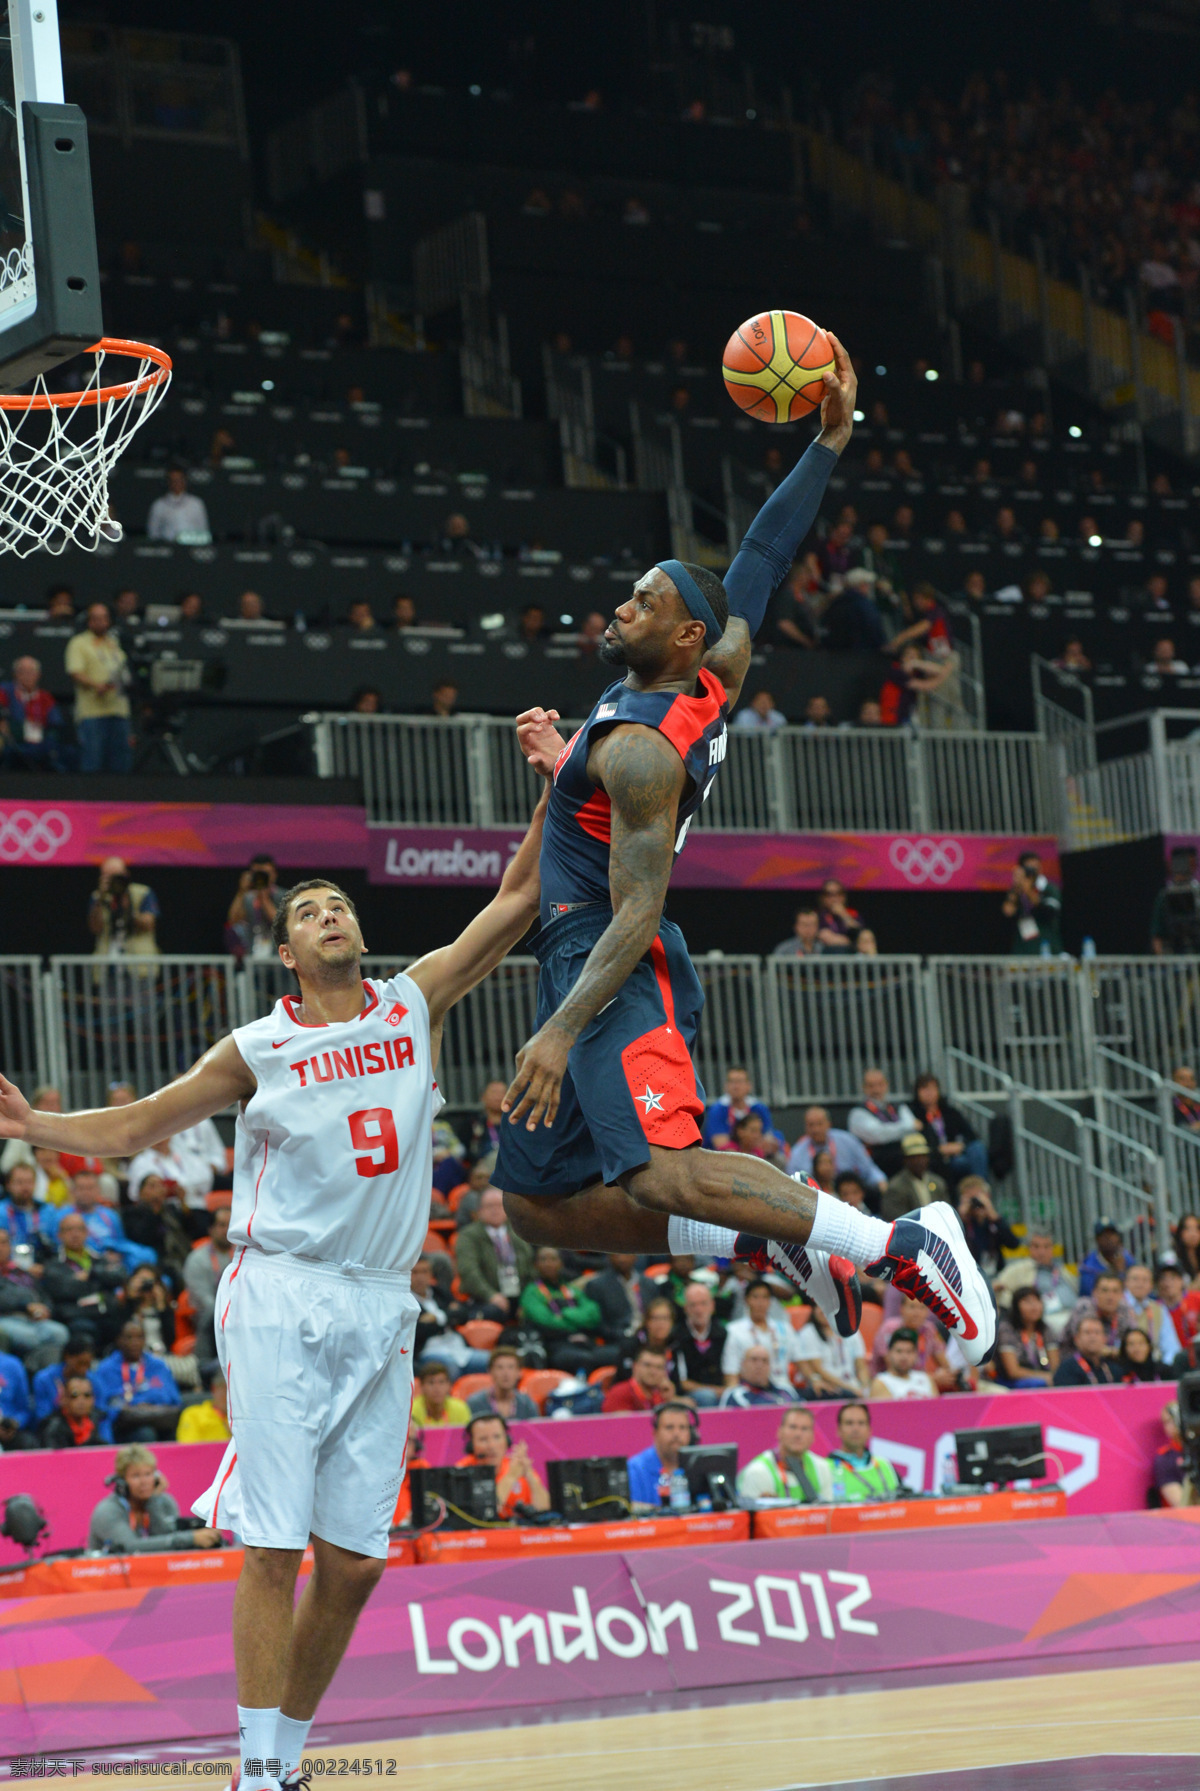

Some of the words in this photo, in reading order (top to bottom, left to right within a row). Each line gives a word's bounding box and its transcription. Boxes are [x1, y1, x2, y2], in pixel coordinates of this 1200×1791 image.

[385, 838, 501, 877] London
[289, 1036, 416, 1087] TUNISIA
[347, 1107, 399, 1178] 9
[409, 1586, 698, 1674] London
[709, 1570, 879, 1646] 2012
